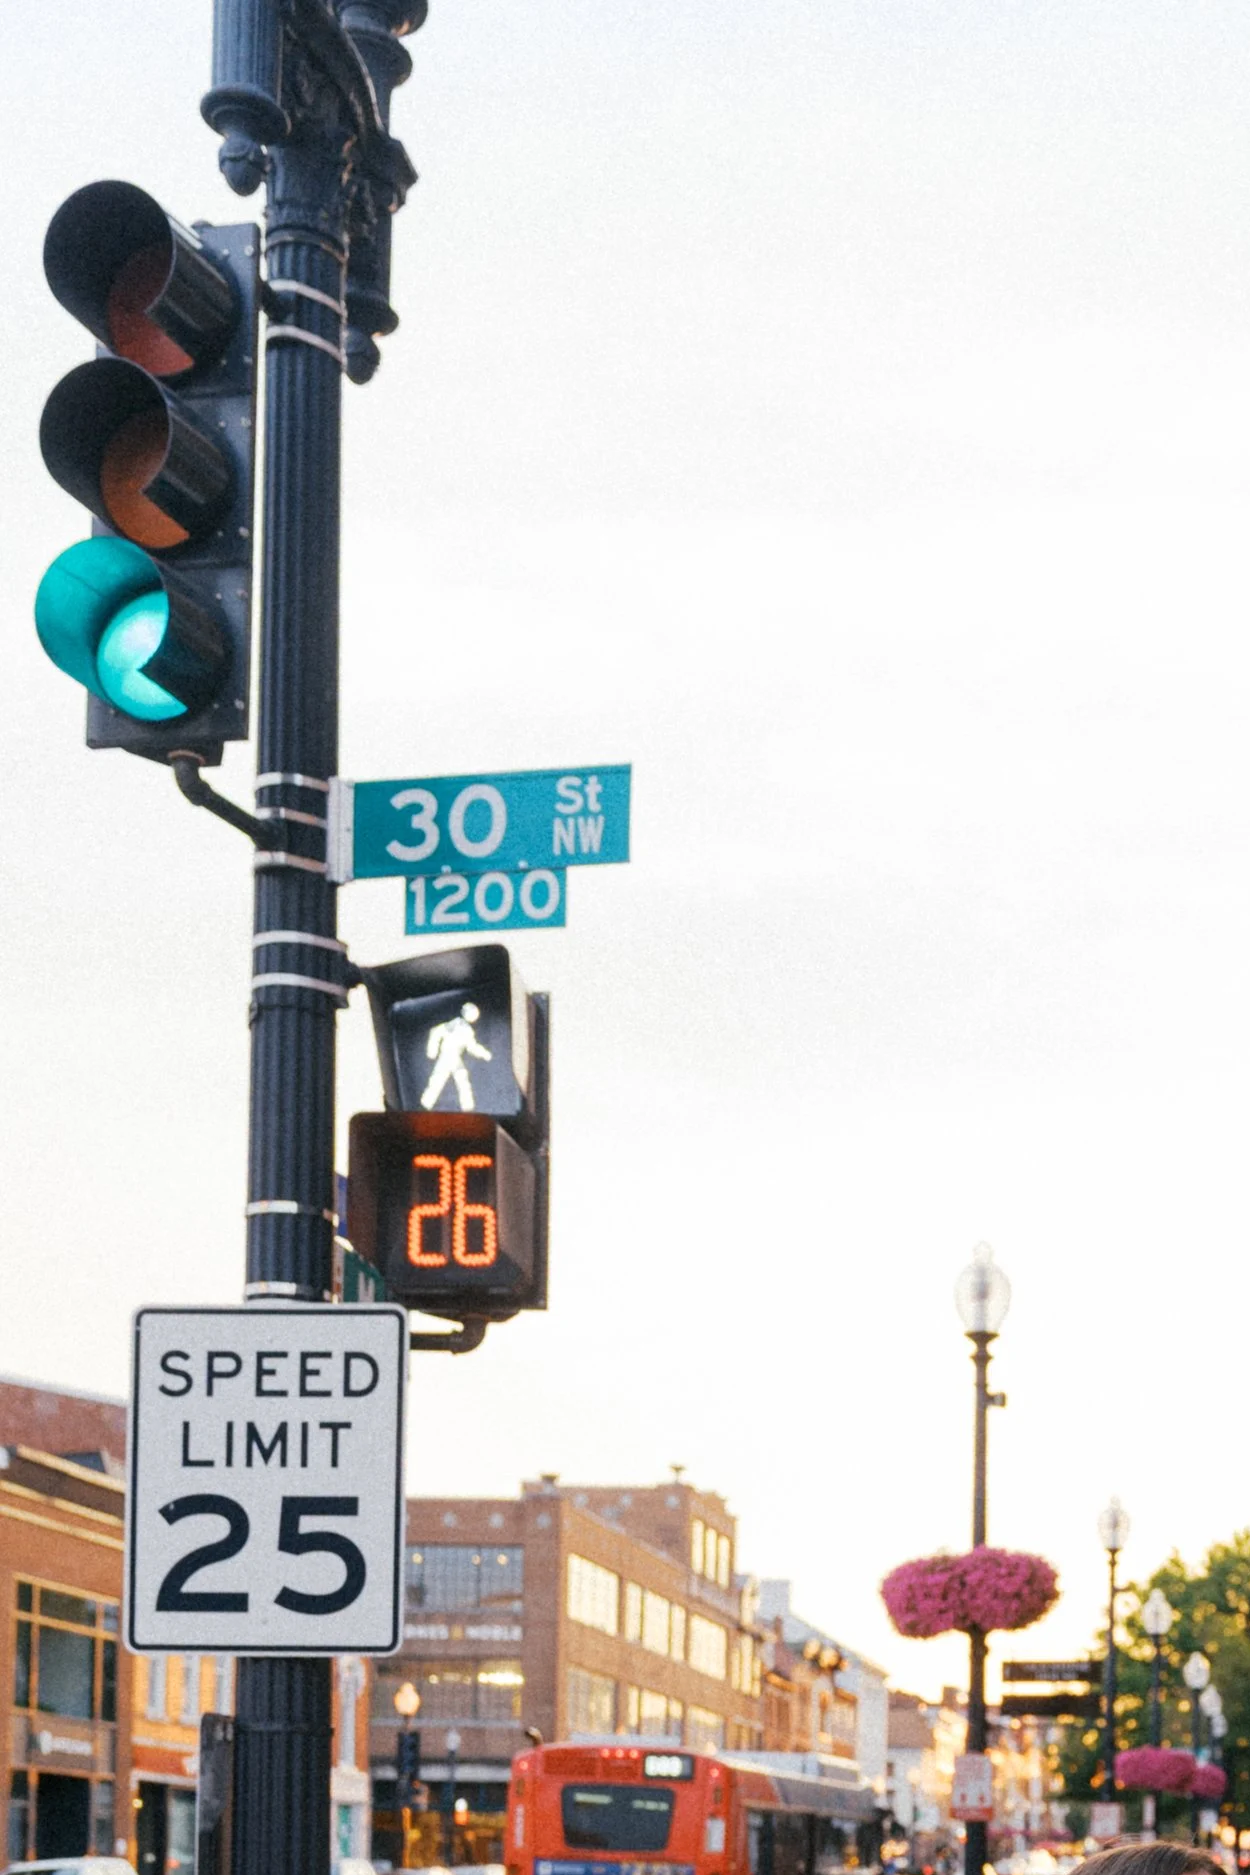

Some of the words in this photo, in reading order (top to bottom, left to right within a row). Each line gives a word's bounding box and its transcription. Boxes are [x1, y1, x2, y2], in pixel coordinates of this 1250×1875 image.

[387, 784, 507, 861] 30
[555, 775, 603, 811] St
[553, 815, 605, 855] NW
[410, 869, 560, 926] 1200
[407, 1154, 498, 1267] 26
[158, 1350, 380, 1398] SPEED
[182, 1421, 352, 1468] LIMIT
[155, 1493, 367, 1616] 25
